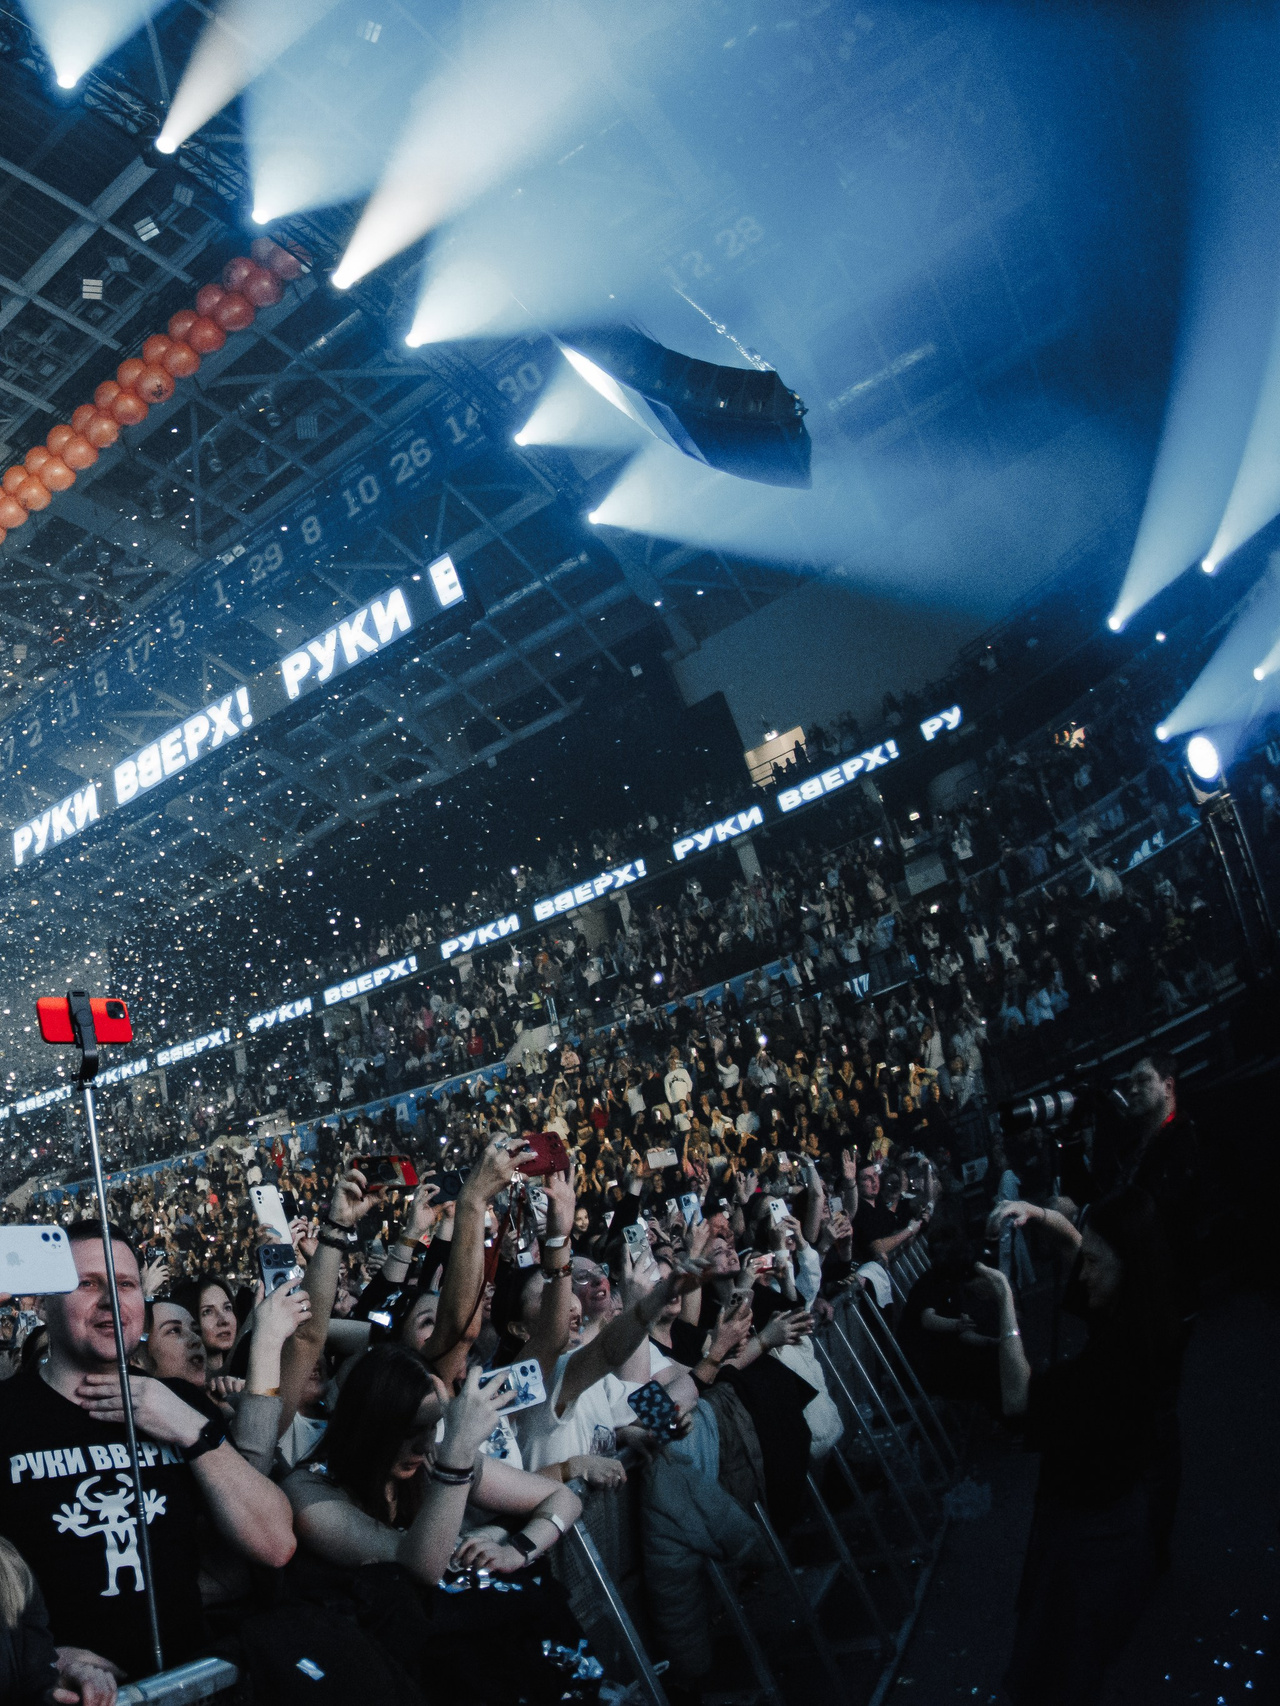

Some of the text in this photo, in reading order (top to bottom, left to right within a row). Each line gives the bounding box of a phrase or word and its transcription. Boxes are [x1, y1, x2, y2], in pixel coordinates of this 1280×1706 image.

[497, 362, 542, 403] 30
[389, 438, 433, 485] 26
[341, 474, 381, 519] 10
[301, 515, 321, 545] 8
[247, 543, 283, 586] 29
[169, 610, 186, 640] 5
[126, 632, 152, 674] 17
[13, 783, 100, 866] РУКИ
[114, 686, 253, 805] ВВЕРХ!
[281, 588, 413, 699] РУКИ
[16, 1085, 72, 1114] ВВЕРХ!
[157, 1028, 231, 1066] ВВЕРХ!
[248, 997, 313, 1033] РУКИ
[323, 956, 418, 1005] ВВЕРХ!
[440, 914, 520, 960] РУКИ
[533, 859, 647, 922] ВВЕРХ!
[673, 806, 765, 861] РУКИ
[777, 739, 901, 813] ВВЕРХ!
[920, 704, 962, 741] РУ
[9, 1447, 87, 1484] РУКИ
